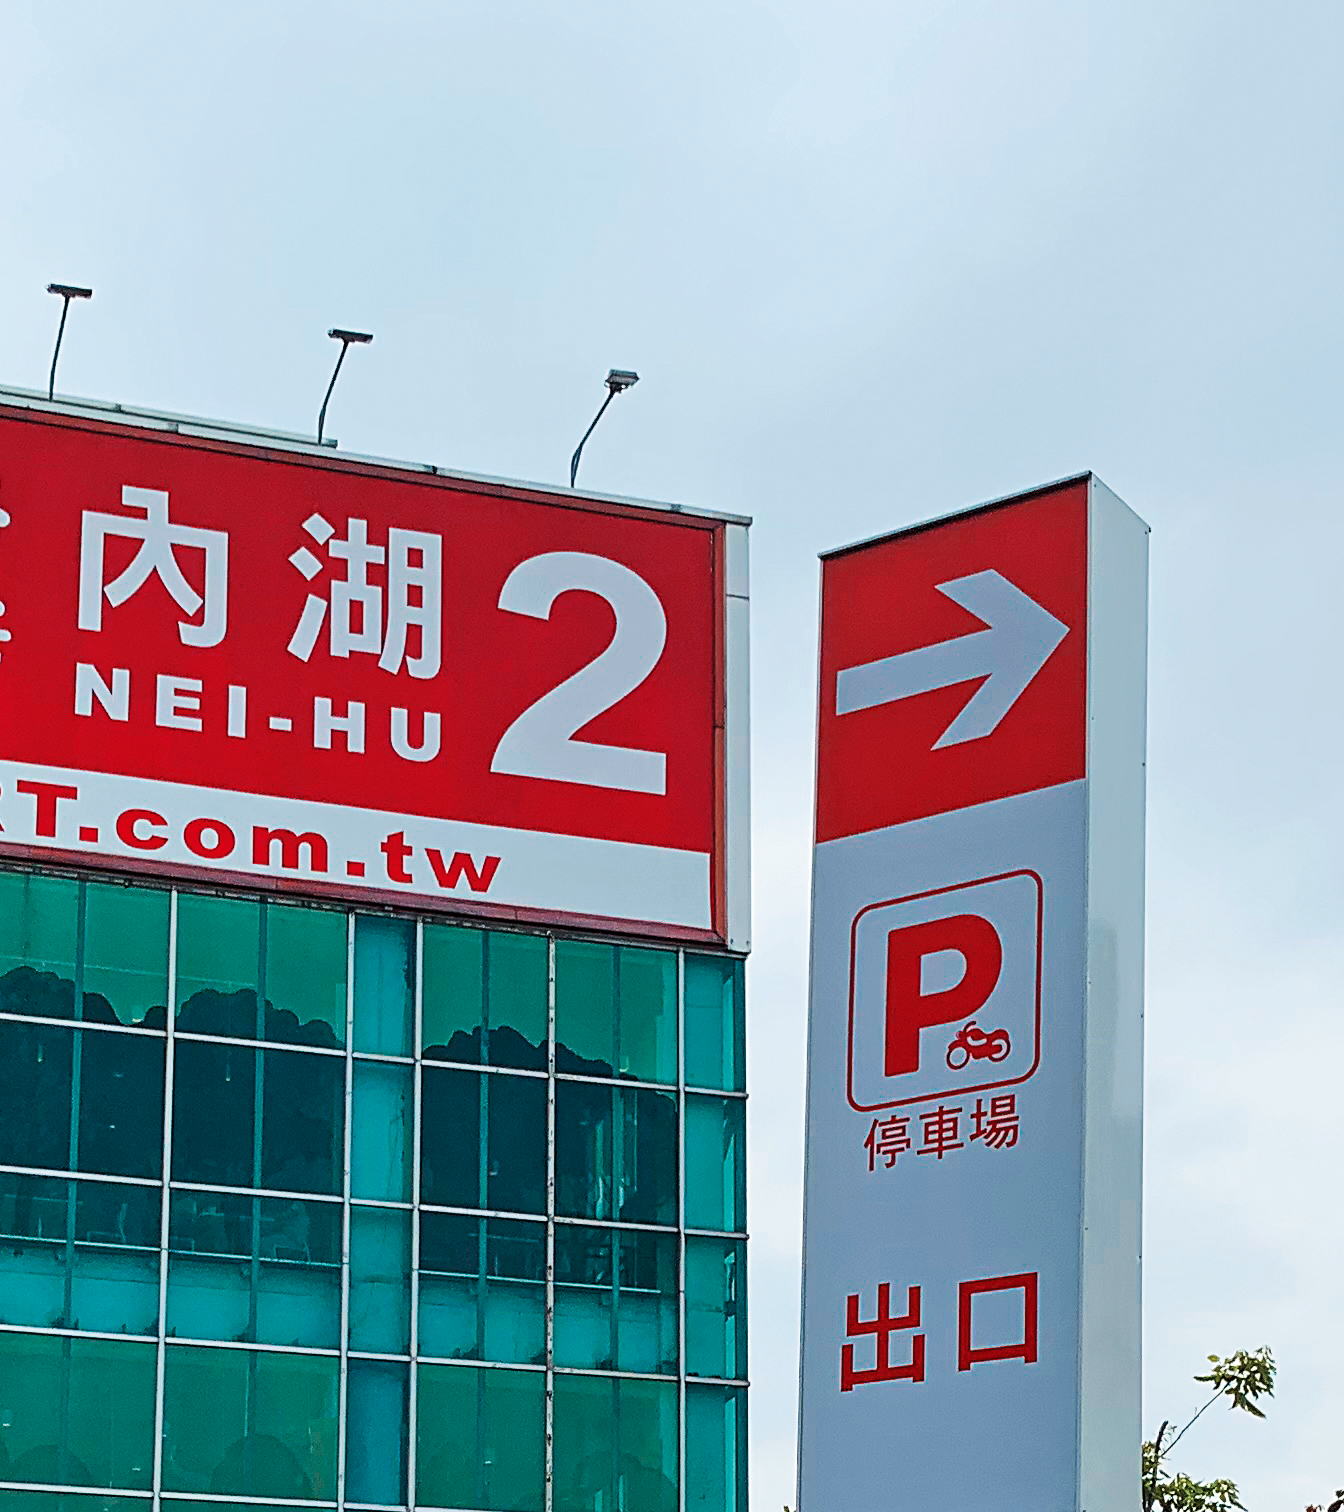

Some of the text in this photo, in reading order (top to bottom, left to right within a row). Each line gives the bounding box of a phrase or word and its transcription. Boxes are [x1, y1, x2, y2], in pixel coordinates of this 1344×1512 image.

[77, 484, 443, 680] 內湖
[489, 550, 668, 797] 2
[74, 661, 442, 763] NEI-HU
[884, 913, 1003, 1077] P
[863, 1093, 1020, 1172] 停車場
[840, 1271, 1039, 1393] 出口
